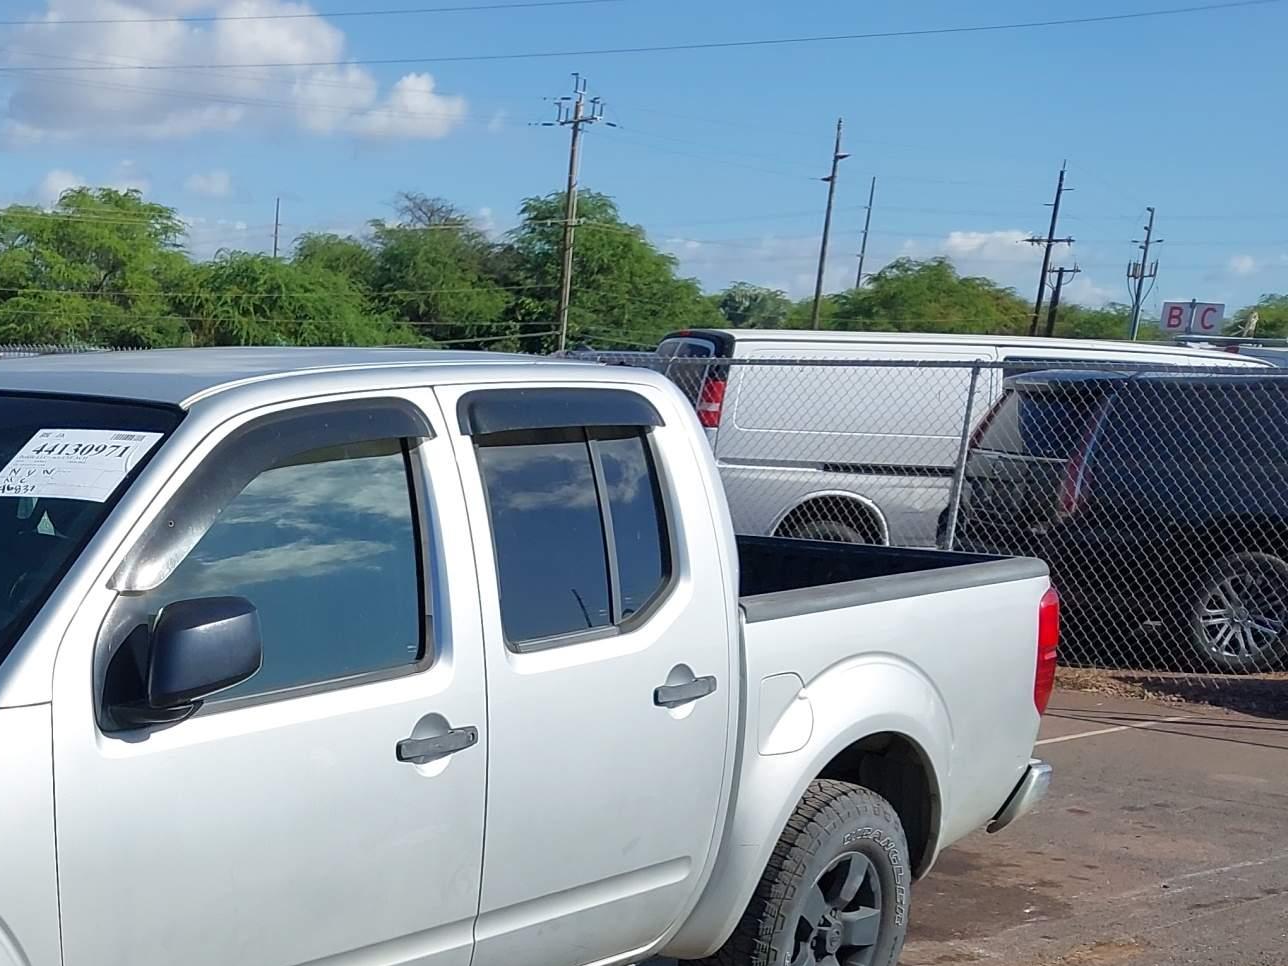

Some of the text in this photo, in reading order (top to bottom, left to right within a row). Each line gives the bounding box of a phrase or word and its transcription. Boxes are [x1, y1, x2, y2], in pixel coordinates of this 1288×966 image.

[1166, 306, 1184, 329] B
[1200, 307, 1218, 330] C
[32, 441, 131, 458] 44130971
